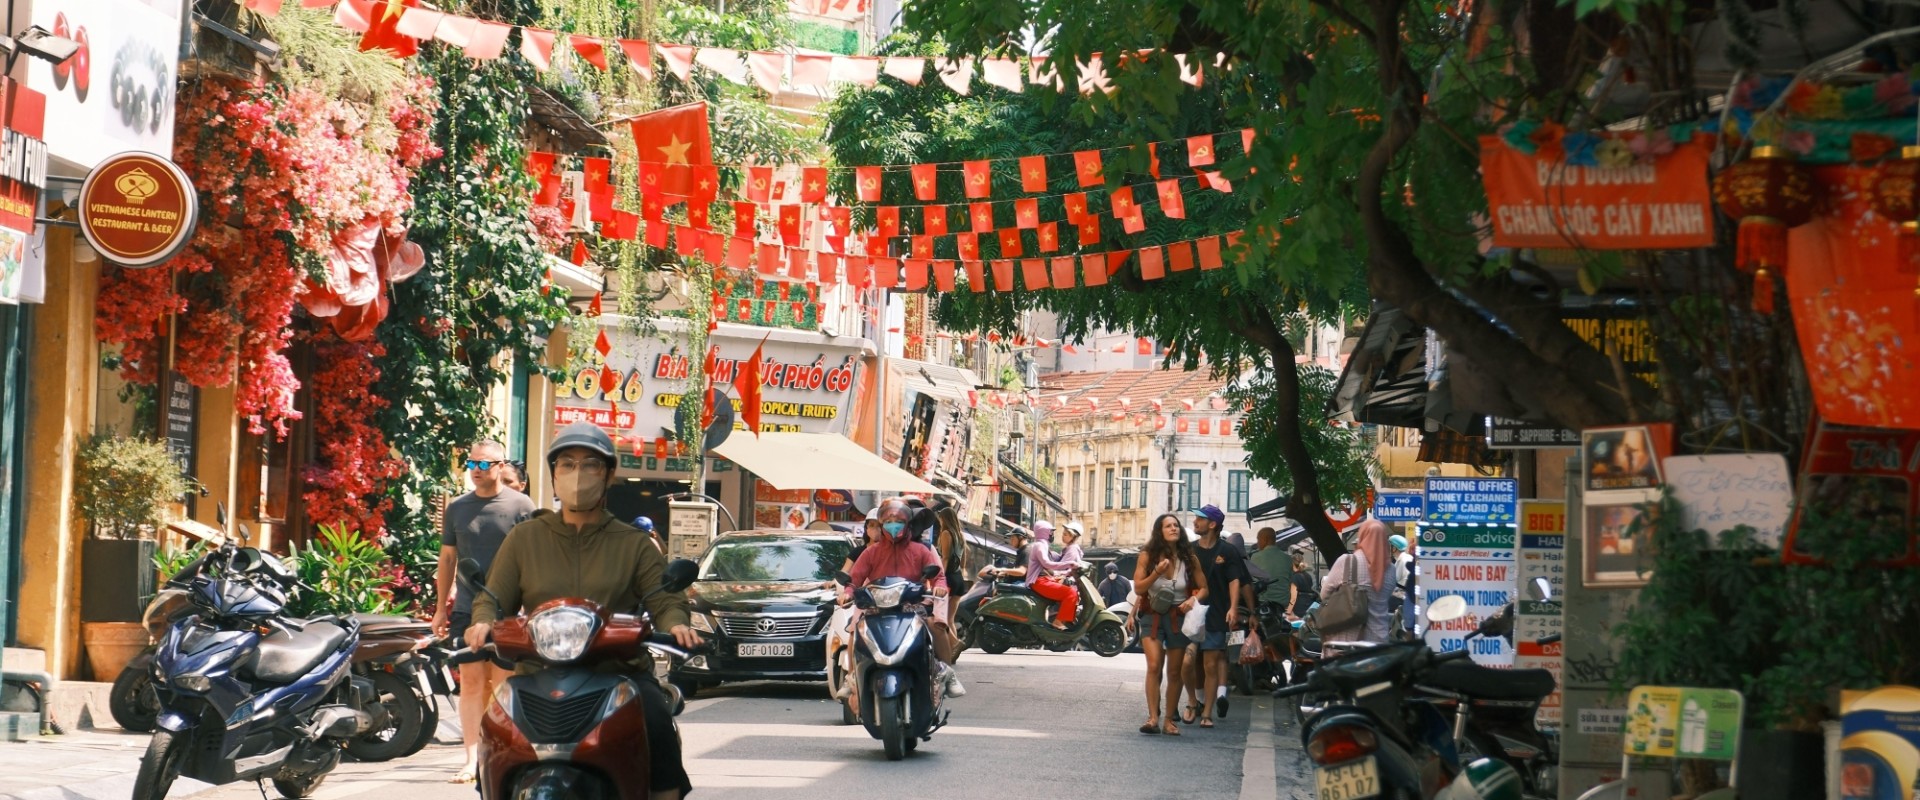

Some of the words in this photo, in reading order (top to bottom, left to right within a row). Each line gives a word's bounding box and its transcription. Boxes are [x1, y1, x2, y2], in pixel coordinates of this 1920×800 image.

[91, 203, 140, 217] VIETNAMESE
[141, 208, 177, 220] LANTERN
[1603, 198, 1644, 235] CÂY
[1649, 202, 1704, 234] XANH
[93, 218, 142, 231] RESTAURANT
[143, 223, 150, 232] &
[151, 223, 172, 234] BEER
[783, 353, 826, 391] PHỐ
[826, 354, 855, 393] CỔ
[802, 404, 837, 419] FRUITS
[1494, 430, 1512, 442] RUBY
[1519, 429, 1554, 442] SAPPHIRE
[1429, 480, 1475, 491] BOOKING
[1478, 481, 1514, 492] OFFICE
[1429, 493, 1461, 503] MONEY
[1464, 494, 1513, 503] EXCHANGE
[1378, 505, 1402, 517] HÀNG
[1404, 507, 1421, 518] BẠC
[1437, 504, 1458, 512] SIM
[1460, 504, 1489, 513] CARD
[1491, 504, 1505, 513] 4G
[1527, 513, 1553, 531] BIG
[1435, 565, 1450, 580] HA
[1453, 566, 1482, 580] LONG
[1486, 566, 1507, 581] BAY
[1477, 590, 1507, 606] TOURS
[1440, 639, 1468, 654] SAPA
[1472, 639, 1501, 654] TOUR
